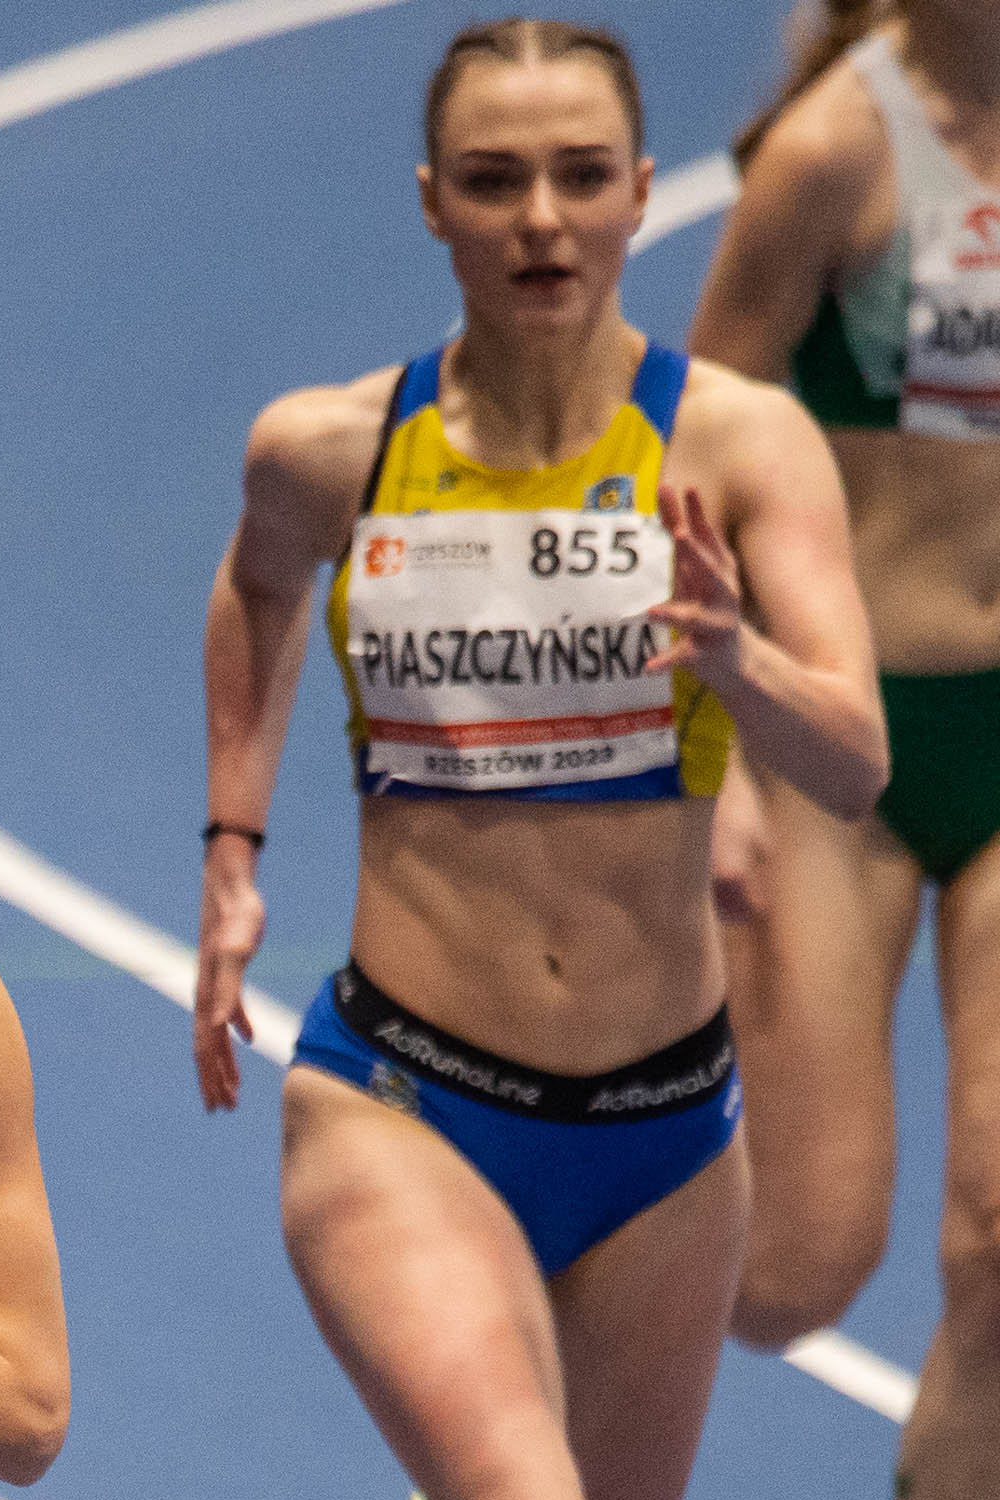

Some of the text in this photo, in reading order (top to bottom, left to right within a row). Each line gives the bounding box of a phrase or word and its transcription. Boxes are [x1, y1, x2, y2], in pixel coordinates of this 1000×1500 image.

[530, 528, 640, 580] 855
[363, 613, 657, 688] PIASZCZYŃSKA
[424, 750, 544, 776] RZESZÓW
